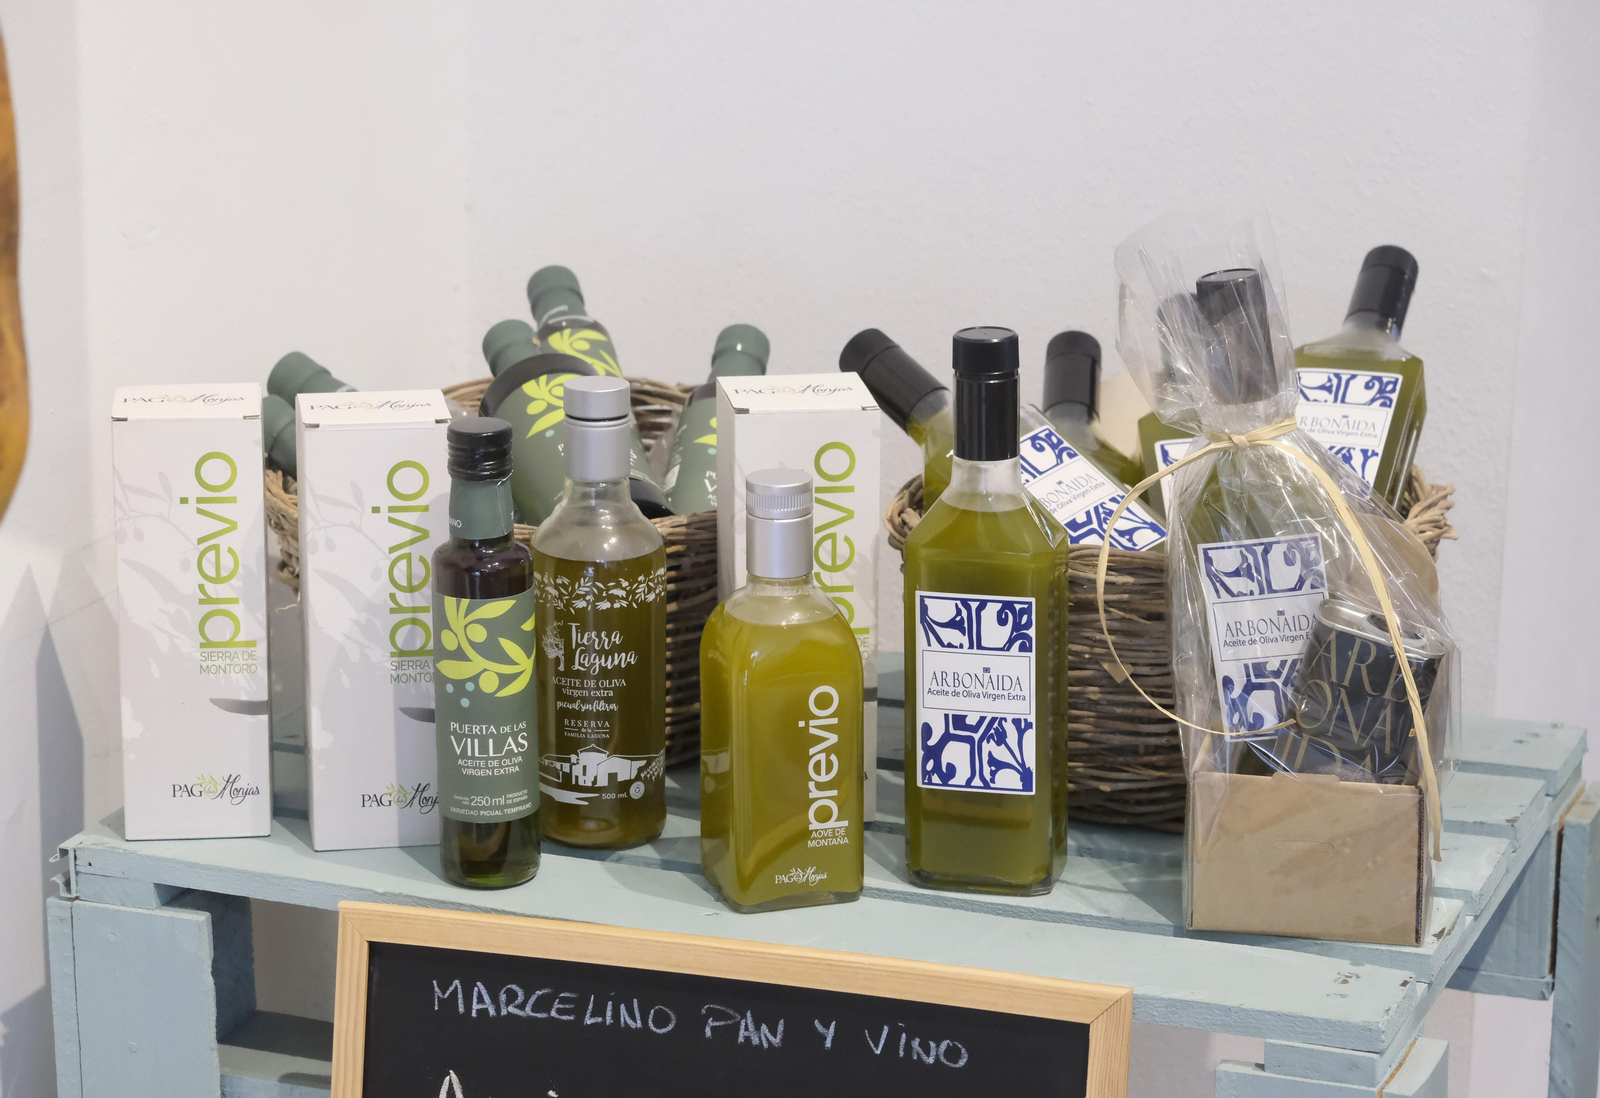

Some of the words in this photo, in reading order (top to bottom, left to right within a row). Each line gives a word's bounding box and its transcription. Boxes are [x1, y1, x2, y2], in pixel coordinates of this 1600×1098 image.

[1299, 416, 1376, 432] RBONAIDA
[1336, 429, 1359, 438] Virgen
[1038, 473, 1098, 509] BONAIDA
[1056, 497, 1073, 510] Oliva
[1071, 488, 1091, 500] Virgen
[1090, 480, 1106, 491] Extra
[179, 451, 257, 649] previo
[371, 460, 434, 658] previo
[567, 622, 624, 650] Tierra
[1223, 639, 1247, 648] Aceite
[1248, 637, 1258, 646] de
[1259, 635, 1278, 645] Oliva
[1279, 633, 1304, 644] Virgen
[200, 651, 239, 662] SIERRA
[241, 650, 257, 661] DE
[571, 646, 638, 676] Laguna
[200, 663, 257, 675] MONTORO
[391, 660, 430, 671] SIERRA
[391, 671, 434, 684] MONTO
[551, 676, 581, 687] ACEITE
[583, 679, 597, 688] DE
[599, 678, 627, 688] OLIVA
[930, 670, 1023, 692] ARBONAIDA
[562, 687, 589, 697] virgen
[591, 688, 614, 697] extra
[927, 687, 950, 697] Aceite
[951, 689, 960, 697] de
[962, 689, 981, 699] Oliva
[982, 691, 1006, 701] Virgen
[1007, 692, 1026, 701] Extra
[450, 721, 498, 735] PUERTA
[500, 725, 512, 734] DE
[514, 720, 527, 731] LAS
[564, 718, 610, 728] RESERVA
[450, 732, 528, 757] VILLAS
[457, 759, 486, 768] ACEITE
[488, 760, 500, 768] DE
[501, 756, 523, 766] OLIVA
[798, 685, 849, 831] previo
[461, 768, 492, 777] VIRGEN
[494, 765, 520, 776] EXTRA
[211, 774, 261, 806] Monjas
[506, 789, 529, 799] PRODUCTO
[601, 792, 616, 800] 500
[470, 796, 491, 807] 250
[492, 795, 505, 806] ml
[449, 806, 479, 816] VARIEDAD
[504, 802, 532, 814] TEMPRANO
[811, 829, 834, 838] AOVE
[835, 828, 846, 836] DE
[808, 835, 849, 848] MONTAÑA
[701, 1004, 784, 1050] PAN
[814, 1018, 836, 1050] Y
